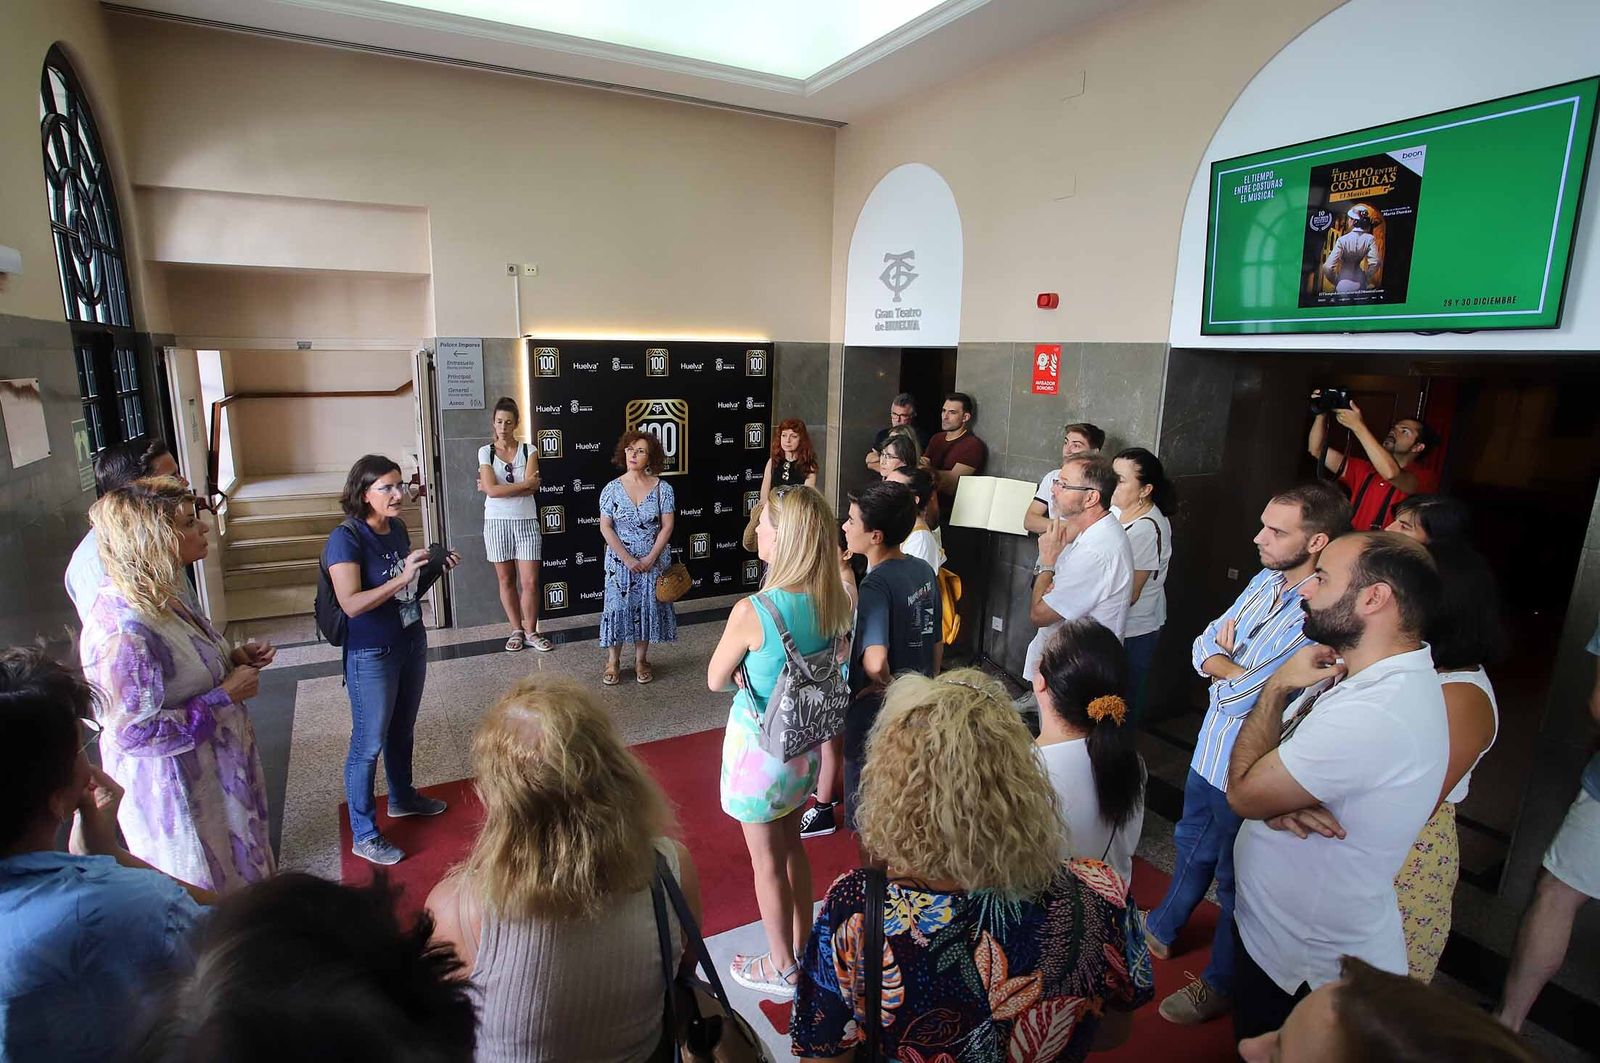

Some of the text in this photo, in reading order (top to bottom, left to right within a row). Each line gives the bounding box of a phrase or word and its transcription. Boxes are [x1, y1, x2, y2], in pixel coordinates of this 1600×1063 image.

[1244, 171, 1274, 184] EL TIEMPO
[1331, 167, 1373, 182] TIEMPO
[1234, 178, 1283, 195] ENTRE COSTURAS
[1330, 172, 1397, 192] COSTURAS
[1240, 190, 1274, 204] EL MUSICAL
[1473, 296, 1517, 305] DICIEMBRE
[875, 307, 922, 319] Gran Teatro
[875, 322, 884, 331] de
[539, 356, 555, 370] 100
[572, 362, 598, 370] Huelva
[650, 356, 665, 370] 100
[680, 362, 703, 370] Huelva
[750, 358, 763, 370] 100
[536, 405, 561, 413] Huelva
[749, 430, 761, 443] 100
[542, 438, 558, 452] 100
[575, 442, 599, 450] Huelva
[539, 485, 564, 493] Huelva
[545, 514, 560, 527] 100
[693, 541, 707, 553] 100
[543, 559, 567, 567] Huelva
[746, 567, 758, 578] 100
[549, 590, 564, 604] 100
